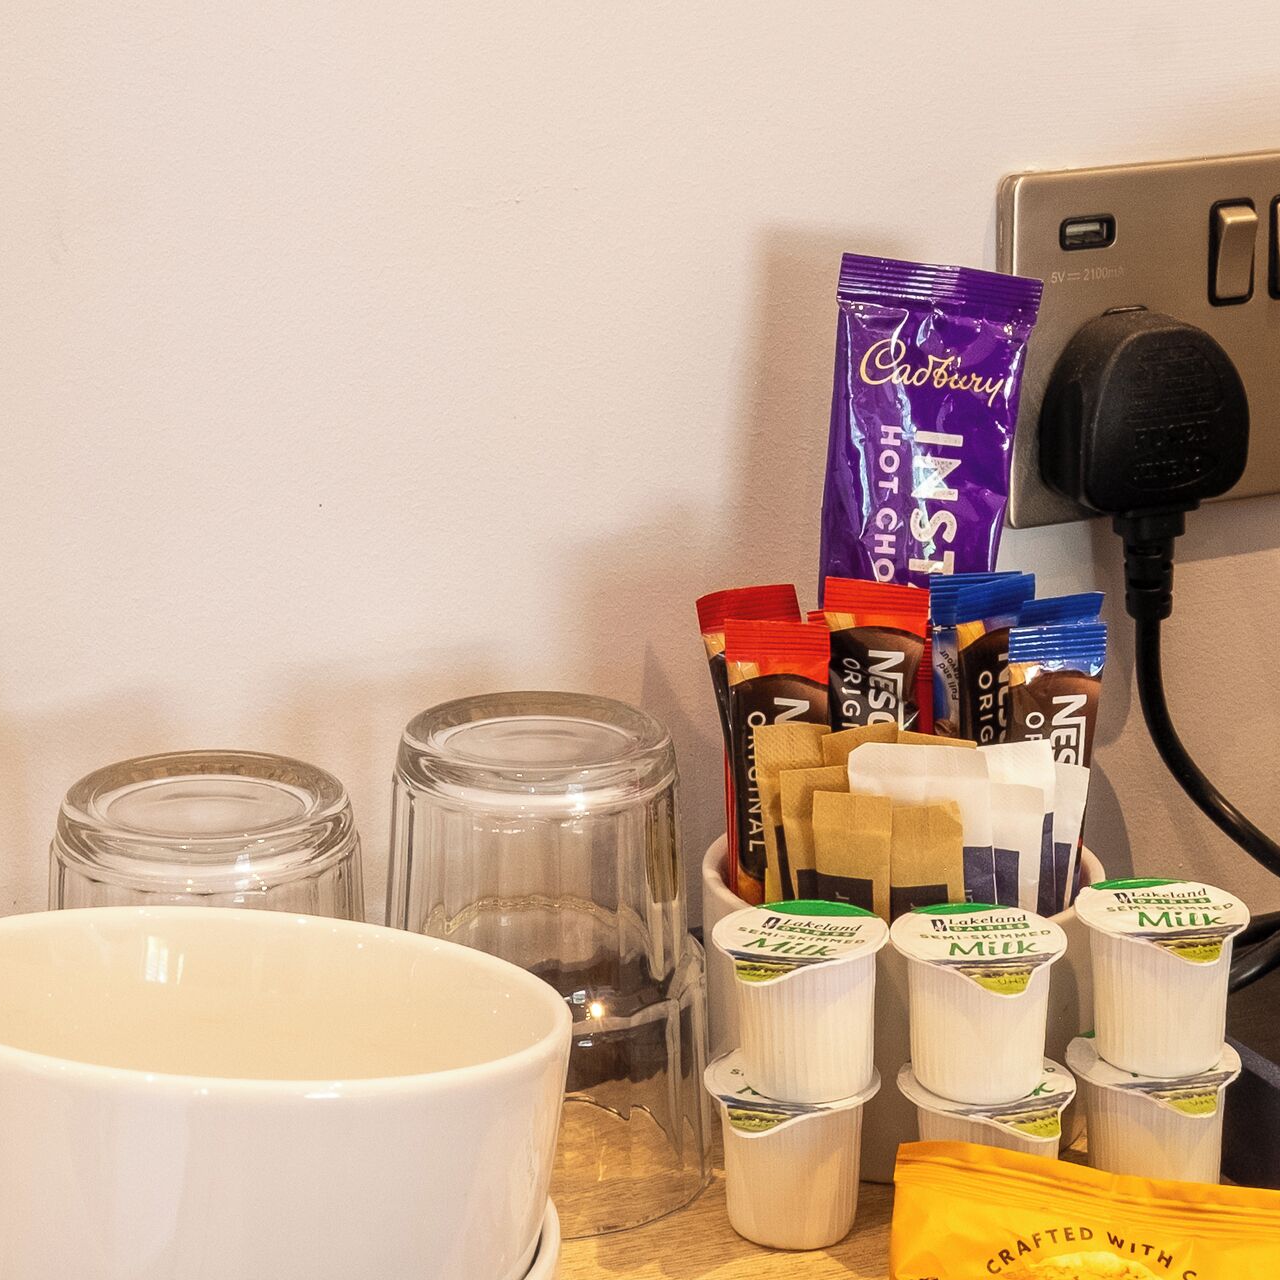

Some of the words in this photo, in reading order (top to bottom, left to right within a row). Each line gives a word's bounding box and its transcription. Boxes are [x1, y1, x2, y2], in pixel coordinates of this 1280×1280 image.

[860, 338, 1008, 407] Cadbury
[878, 424, 902, 495] HOT
[908, 430, 964, 588] INST
[1131, 887, 1208, 899] Lakeland
[1106, 902, 1234, 912] SEMI-SKIMMED
[783, 918, 863, 933] Lakeland
[948, 914, 1027, 926] Lakeland
[1138, 911, 1227, 928] Milk
[738, 926, 867, 945] SEMI-SKIMMED
[919, 929, 1052, 941] SEMI-SKIMMED
[742, 938, 837, 957] Milk
[949, 940, 1041, 956] Milk
[986, 1226, 1094, 1275] CRAFTED
[1106, 1231, 1174, 1269] WITH
